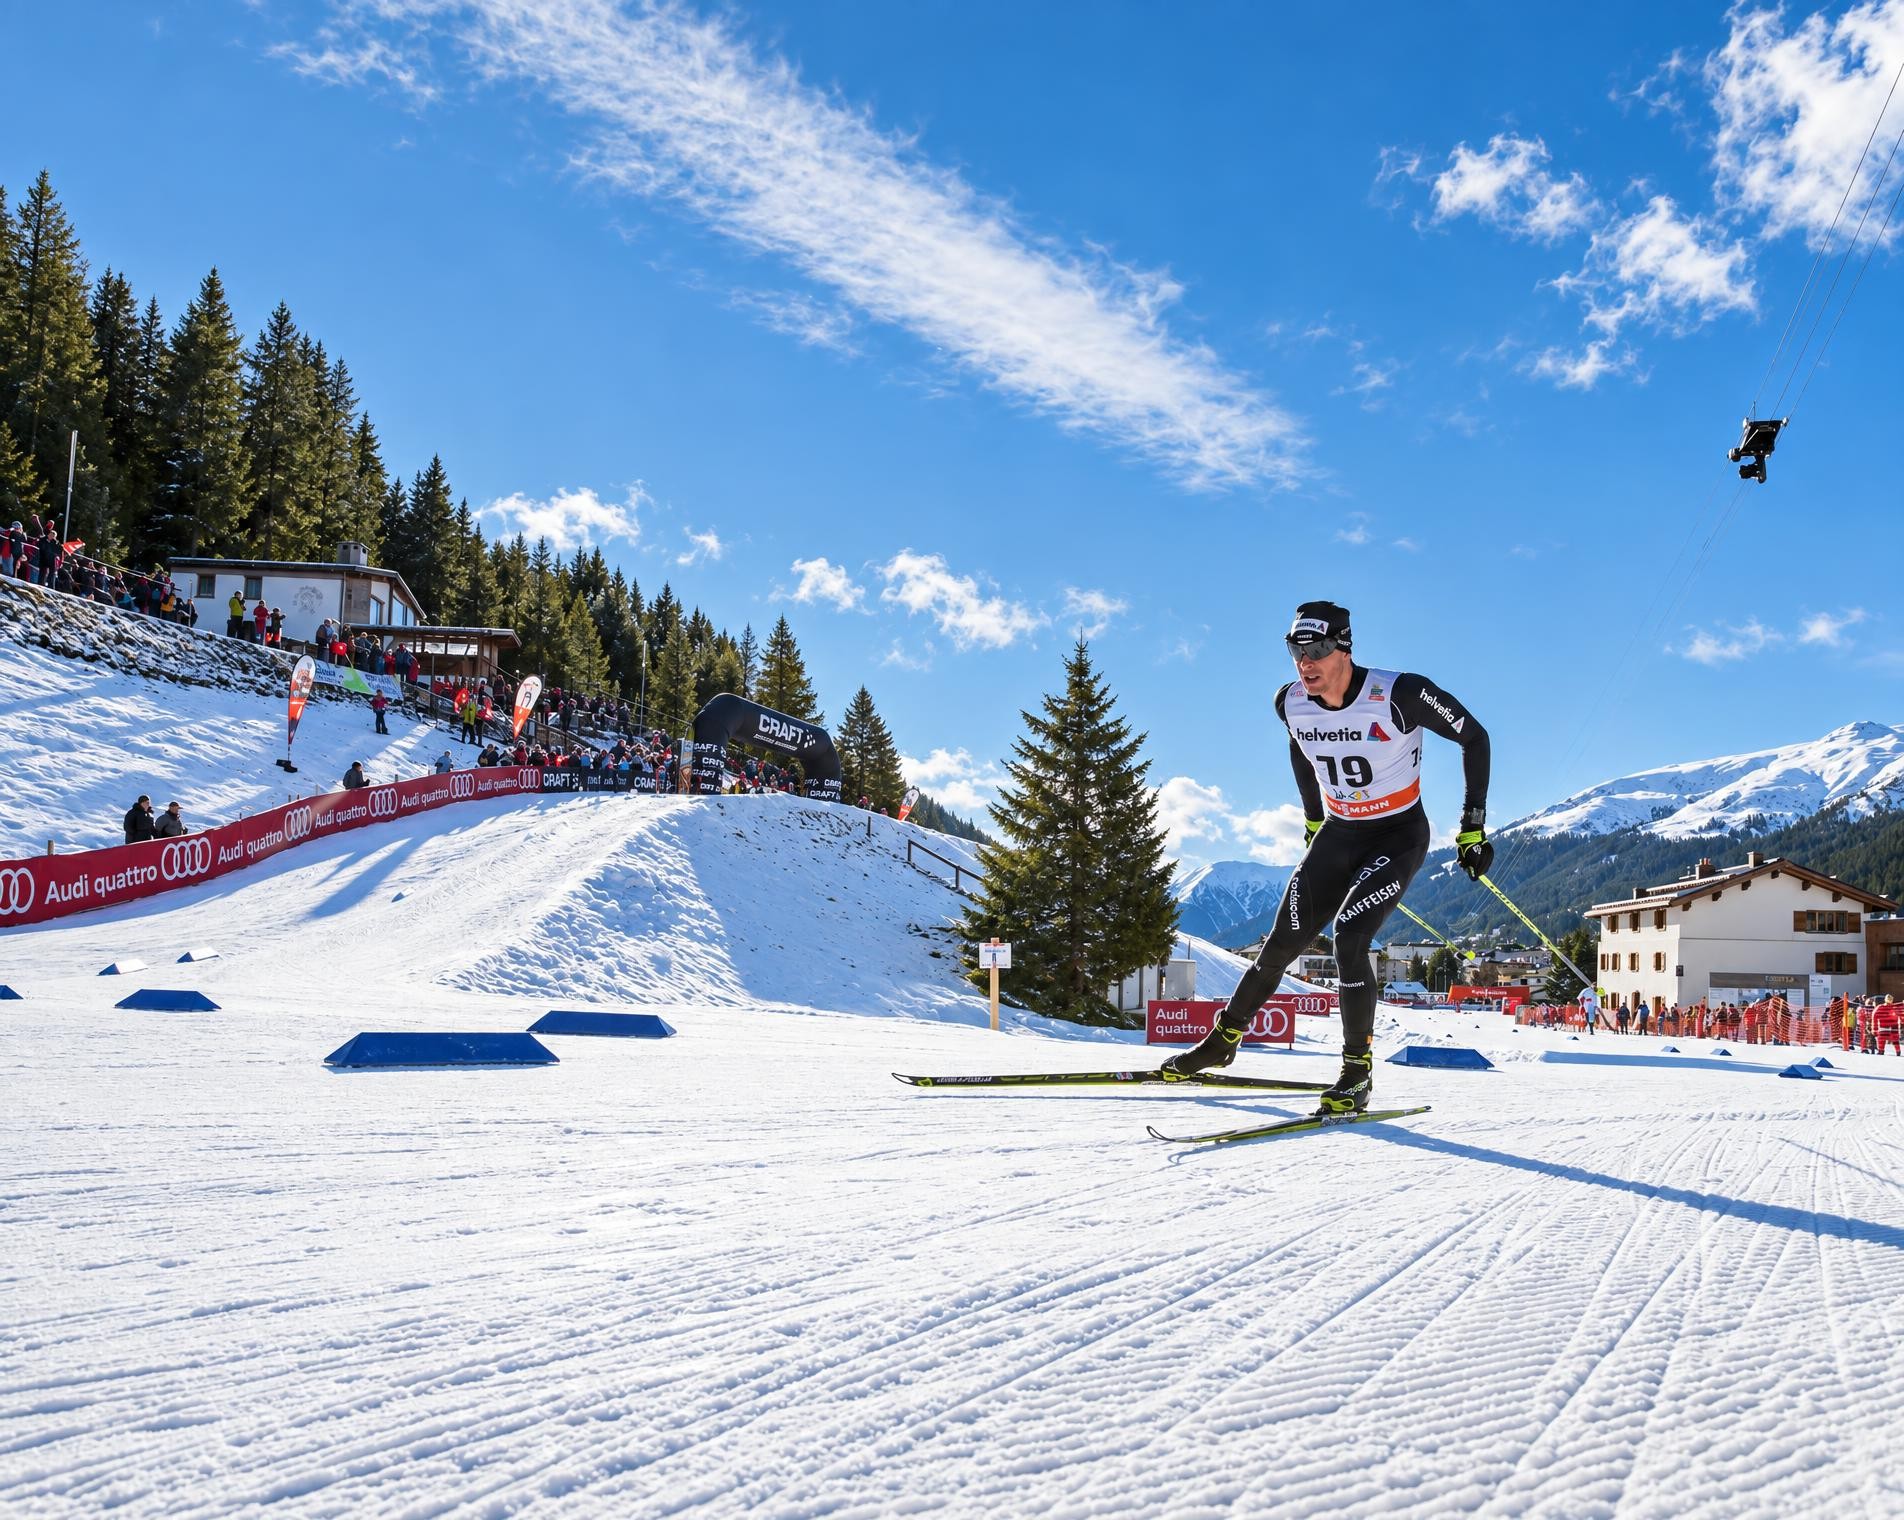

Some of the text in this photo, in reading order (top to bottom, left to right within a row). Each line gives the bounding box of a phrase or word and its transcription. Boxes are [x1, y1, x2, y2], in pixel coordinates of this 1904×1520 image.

[1420, 688, 1454, 723] helvetia
[759, 714, 803, 744] CRAFT
[1297, 728, 1361, 741] helvetia
[478, 777, 517, 792] Audi quattro
[543, 773, 570, 787] CRAFT
[634, 776, 656, 789] CRAF
[401, 789, 448, 808] Audi quattro
[315, 805, 367, 828] Audi quattro
[218, 831, 283, 865] Audi quattro
[45, 865, 158, 905] Audi quattro
[1338, 880, 1400, 923] RAIFFEISEN
[1155, 1008, 1188, 1020] Audi
[1155, 1024, 1207, 1036] quattro
